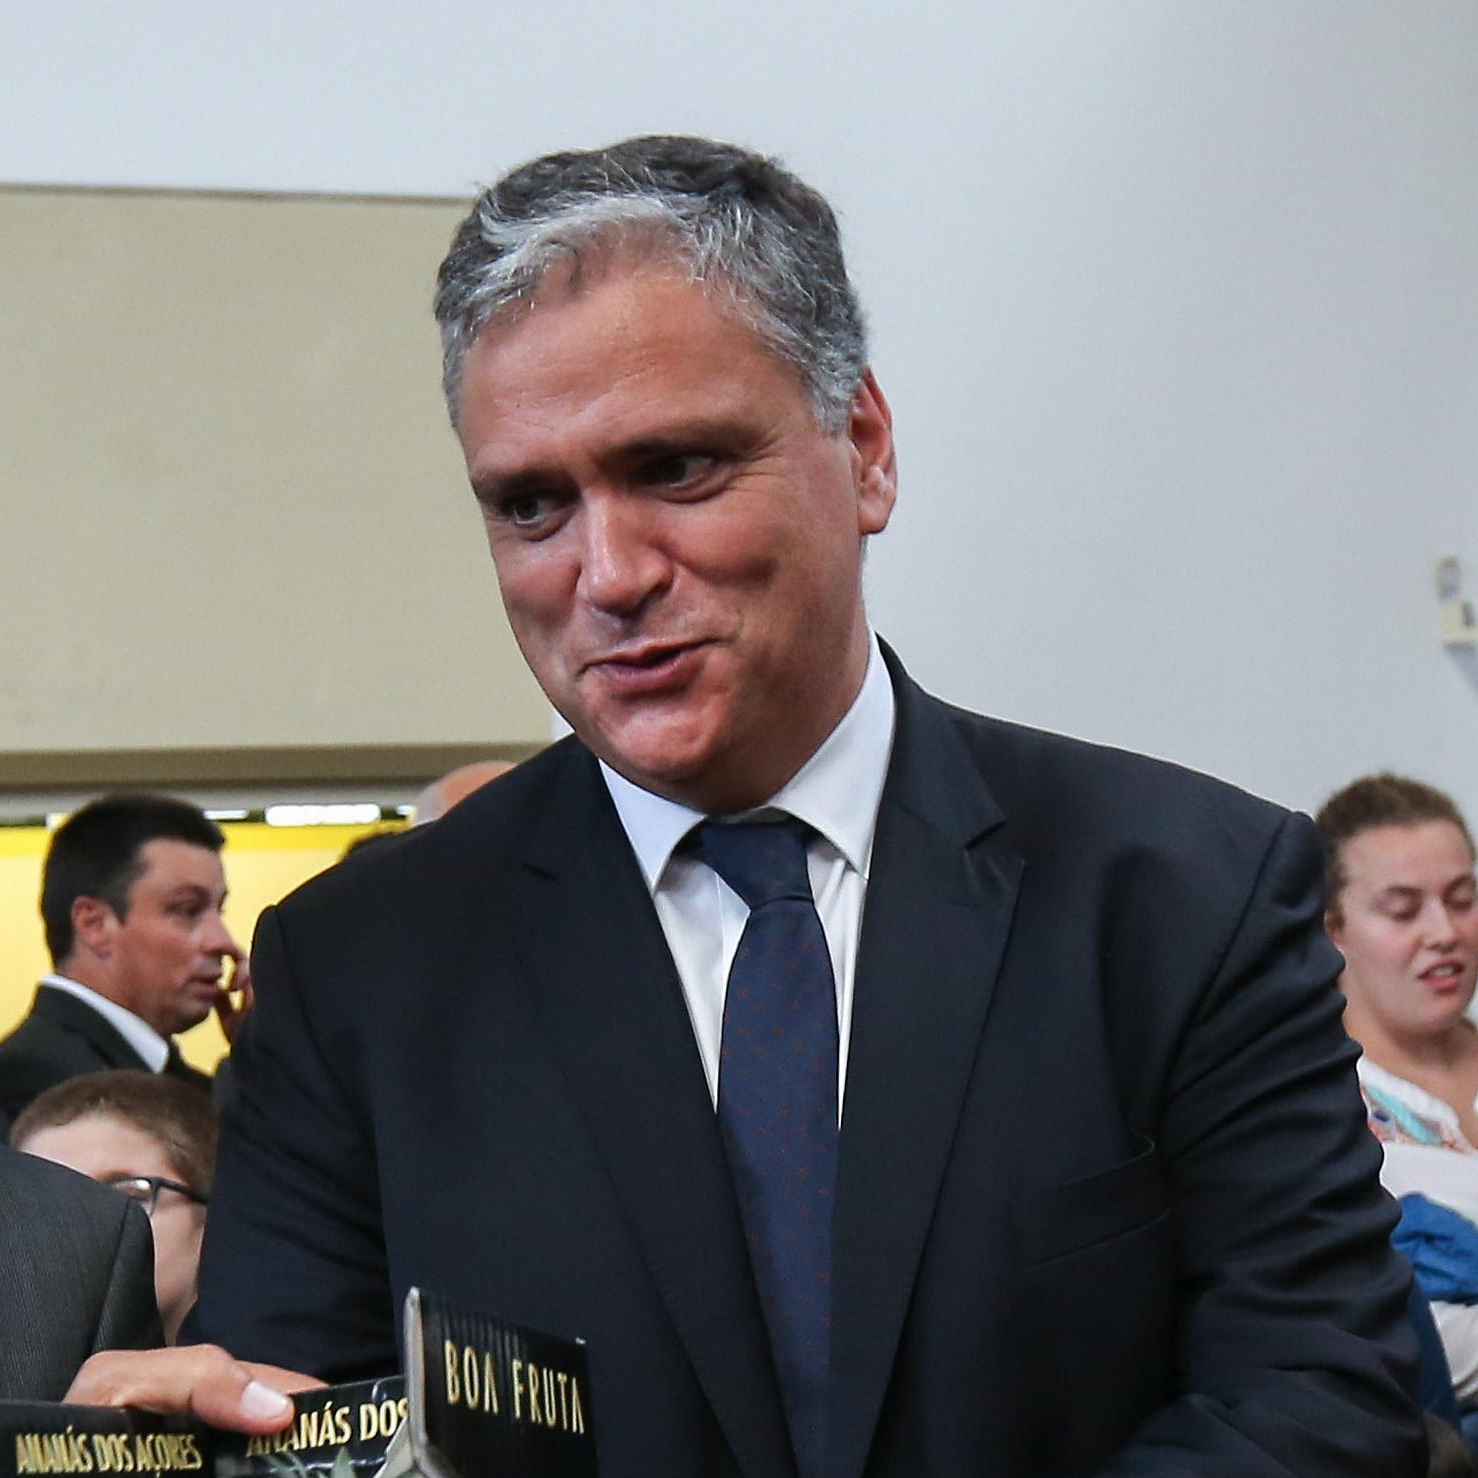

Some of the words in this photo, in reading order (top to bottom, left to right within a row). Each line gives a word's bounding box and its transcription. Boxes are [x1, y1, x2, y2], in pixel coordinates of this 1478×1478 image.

[444, 1339, 499, 1415] BOA
[512, 1358, 585, 1435] FRUTA
[15, 1424, 94, 1476] ANANÁS
[92, 1432, 135, 1473] DOS
